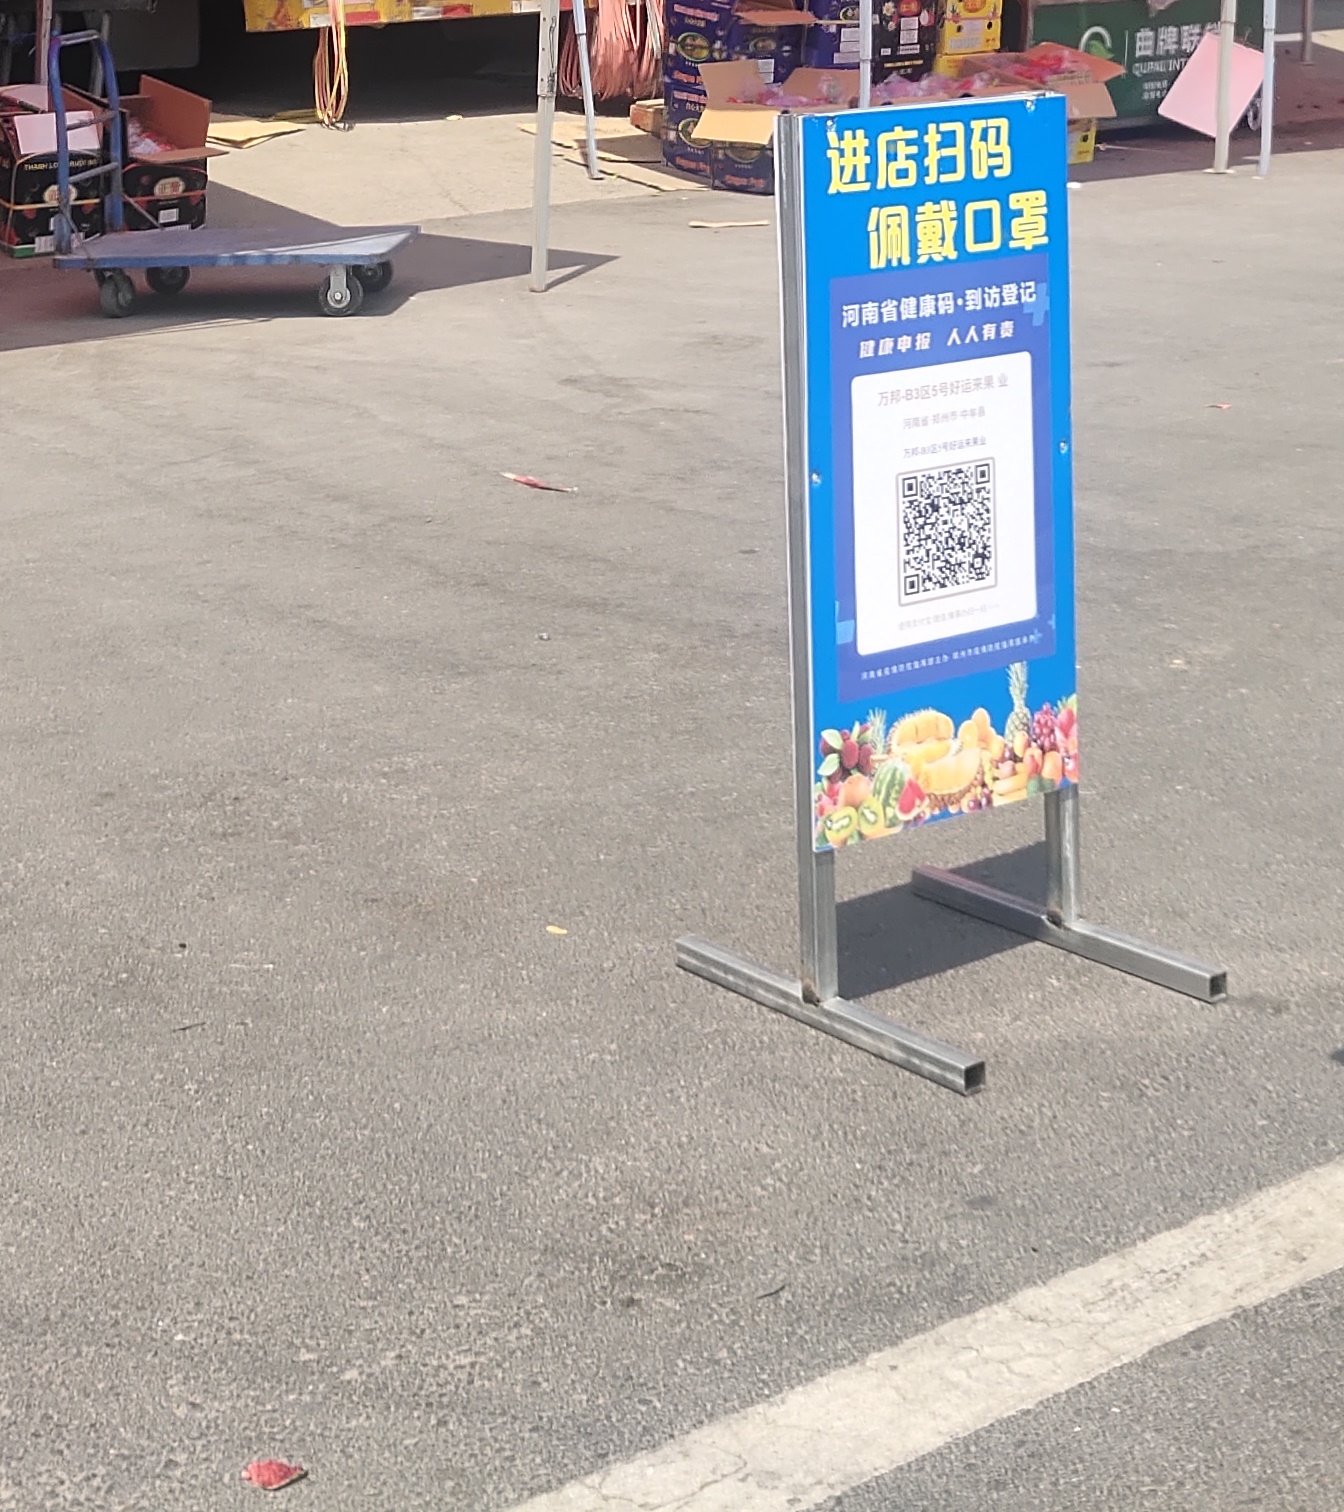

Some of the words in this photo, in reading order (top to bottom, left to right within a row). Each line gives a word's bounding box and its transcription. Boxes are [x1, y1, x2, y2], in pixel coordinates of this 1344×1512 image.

[826, 117, 1012, 194] 进店扫码
[868, 190, 1049, 269] 佩戴口罩
[842, 281, 1037, 328] 河南省健康码·到访登记
[859, 332, 933, 358] 健康申报
[946, 321, 1015, 347] 人人有责
